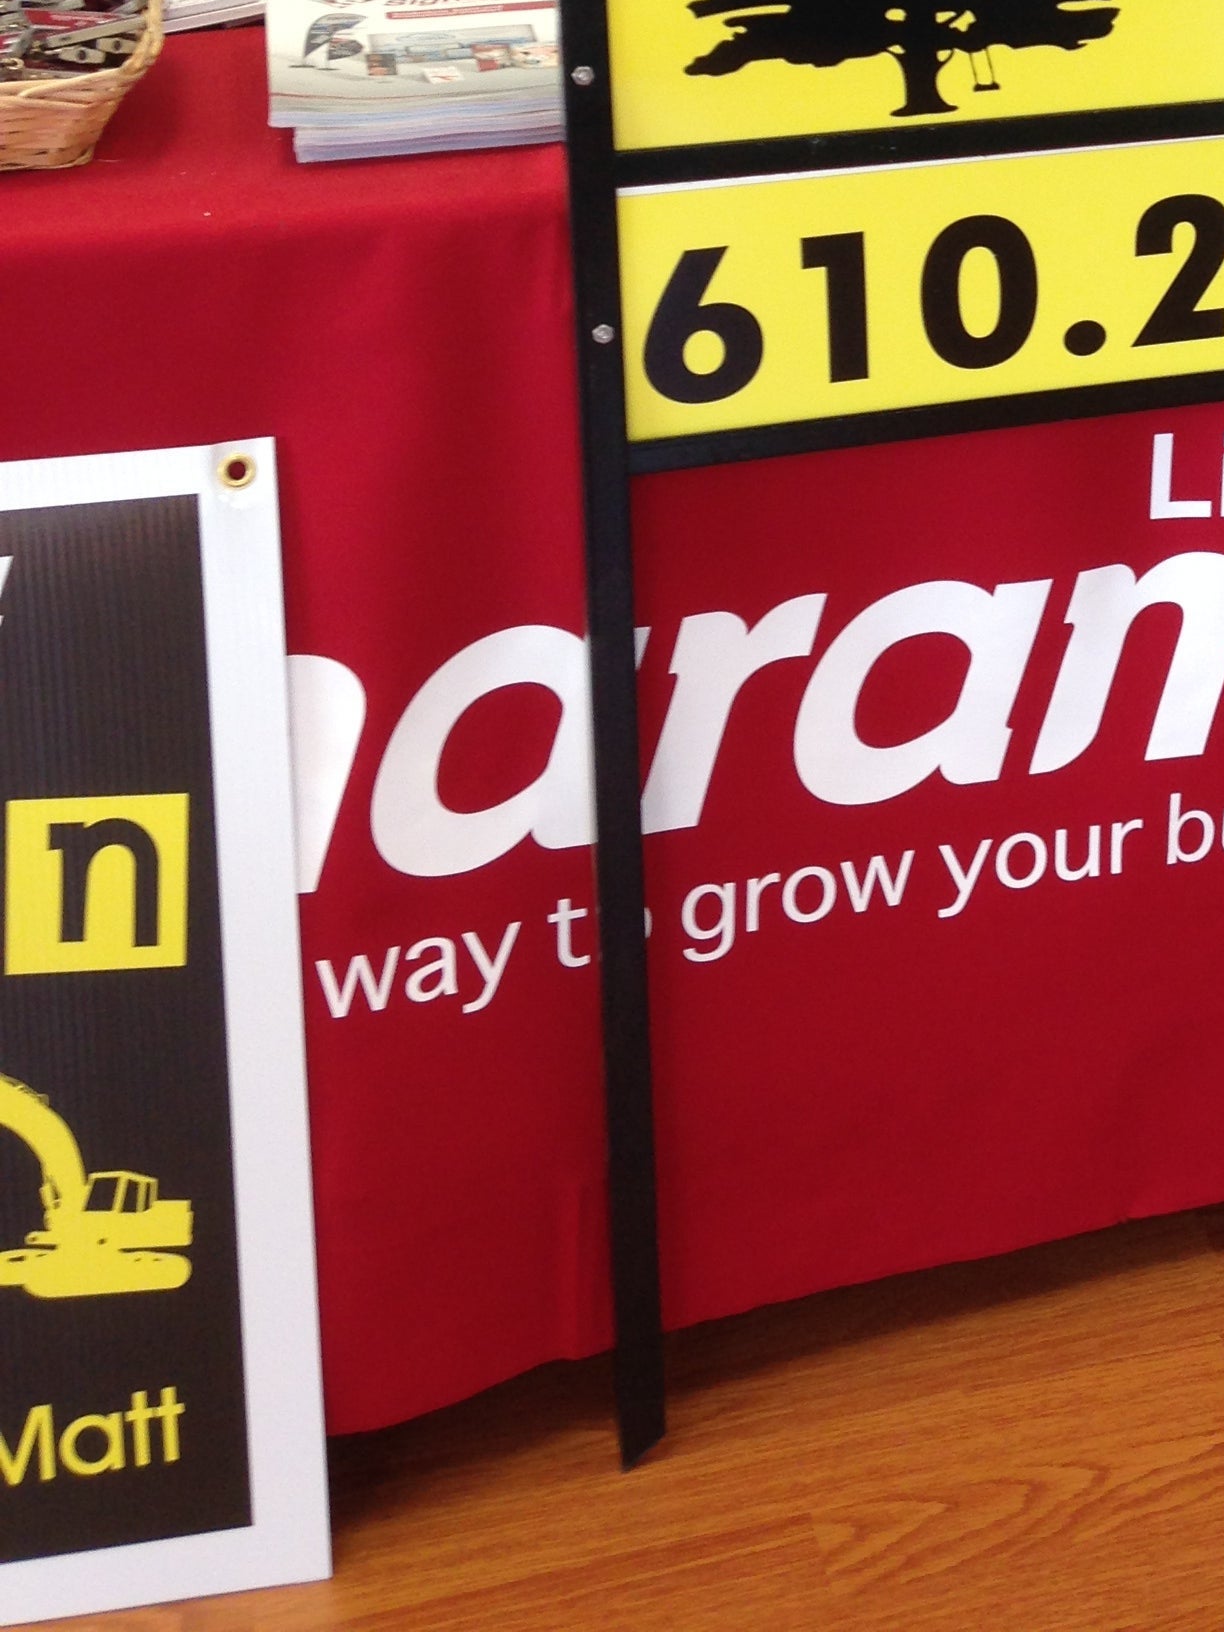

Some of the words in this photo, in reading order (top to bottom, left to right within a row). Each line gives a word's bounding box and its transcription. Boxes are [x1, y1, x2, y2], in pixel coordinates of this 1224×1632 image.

[316, 922, 522, 1019] way
[547, 898, 652, 968] t
[681, 847, 914, 963] grow
[938, 814, 1144, 918] your
[0, 1386, 186, 1486] Matt
